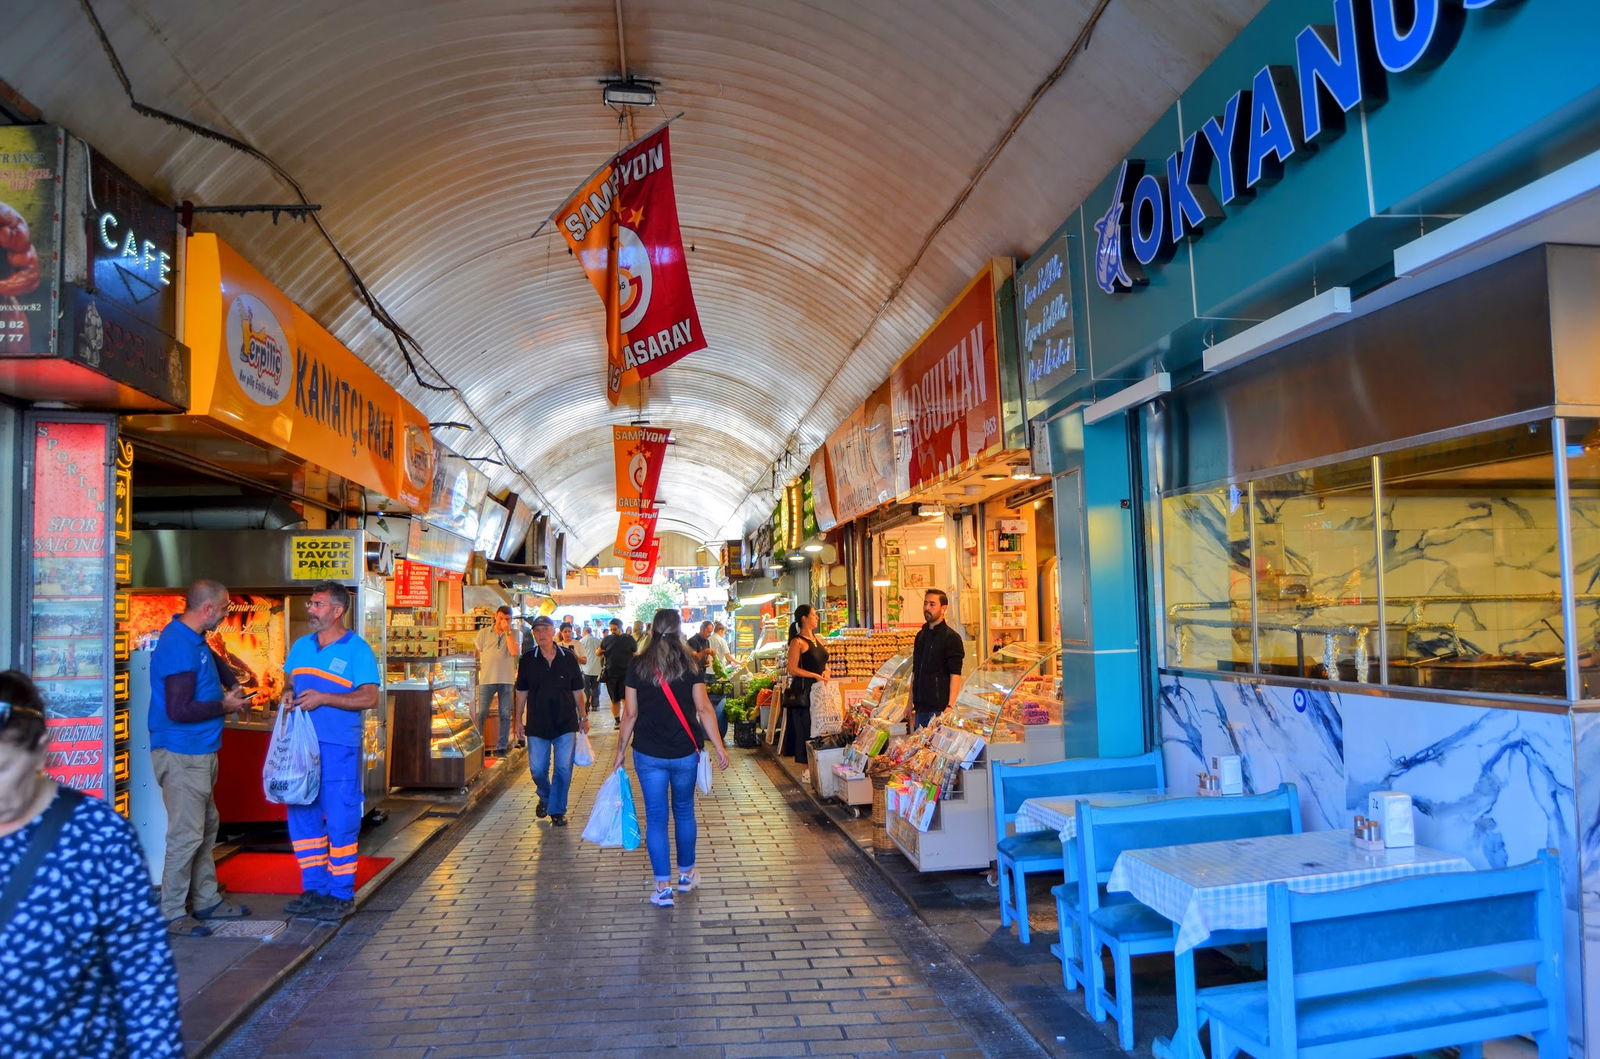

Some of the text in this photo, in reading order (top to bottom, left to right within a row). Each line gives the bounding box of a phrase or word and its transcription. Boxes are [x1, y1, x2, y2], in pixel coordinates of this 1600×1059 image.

[1130, 0, 1495, 265] OKYANU
[563, 141, 665, 242] ŞAMPYON
[100, 212, 171, 285] CAFE
[48, 517, 96, 532] SPOR
[33, 538, 104, 553] SALONU
[296, 539, 351, 549] KÖZDE
[298, 560, 349, 568] PAKET
[44, 750, 102, 766] ITNESS
